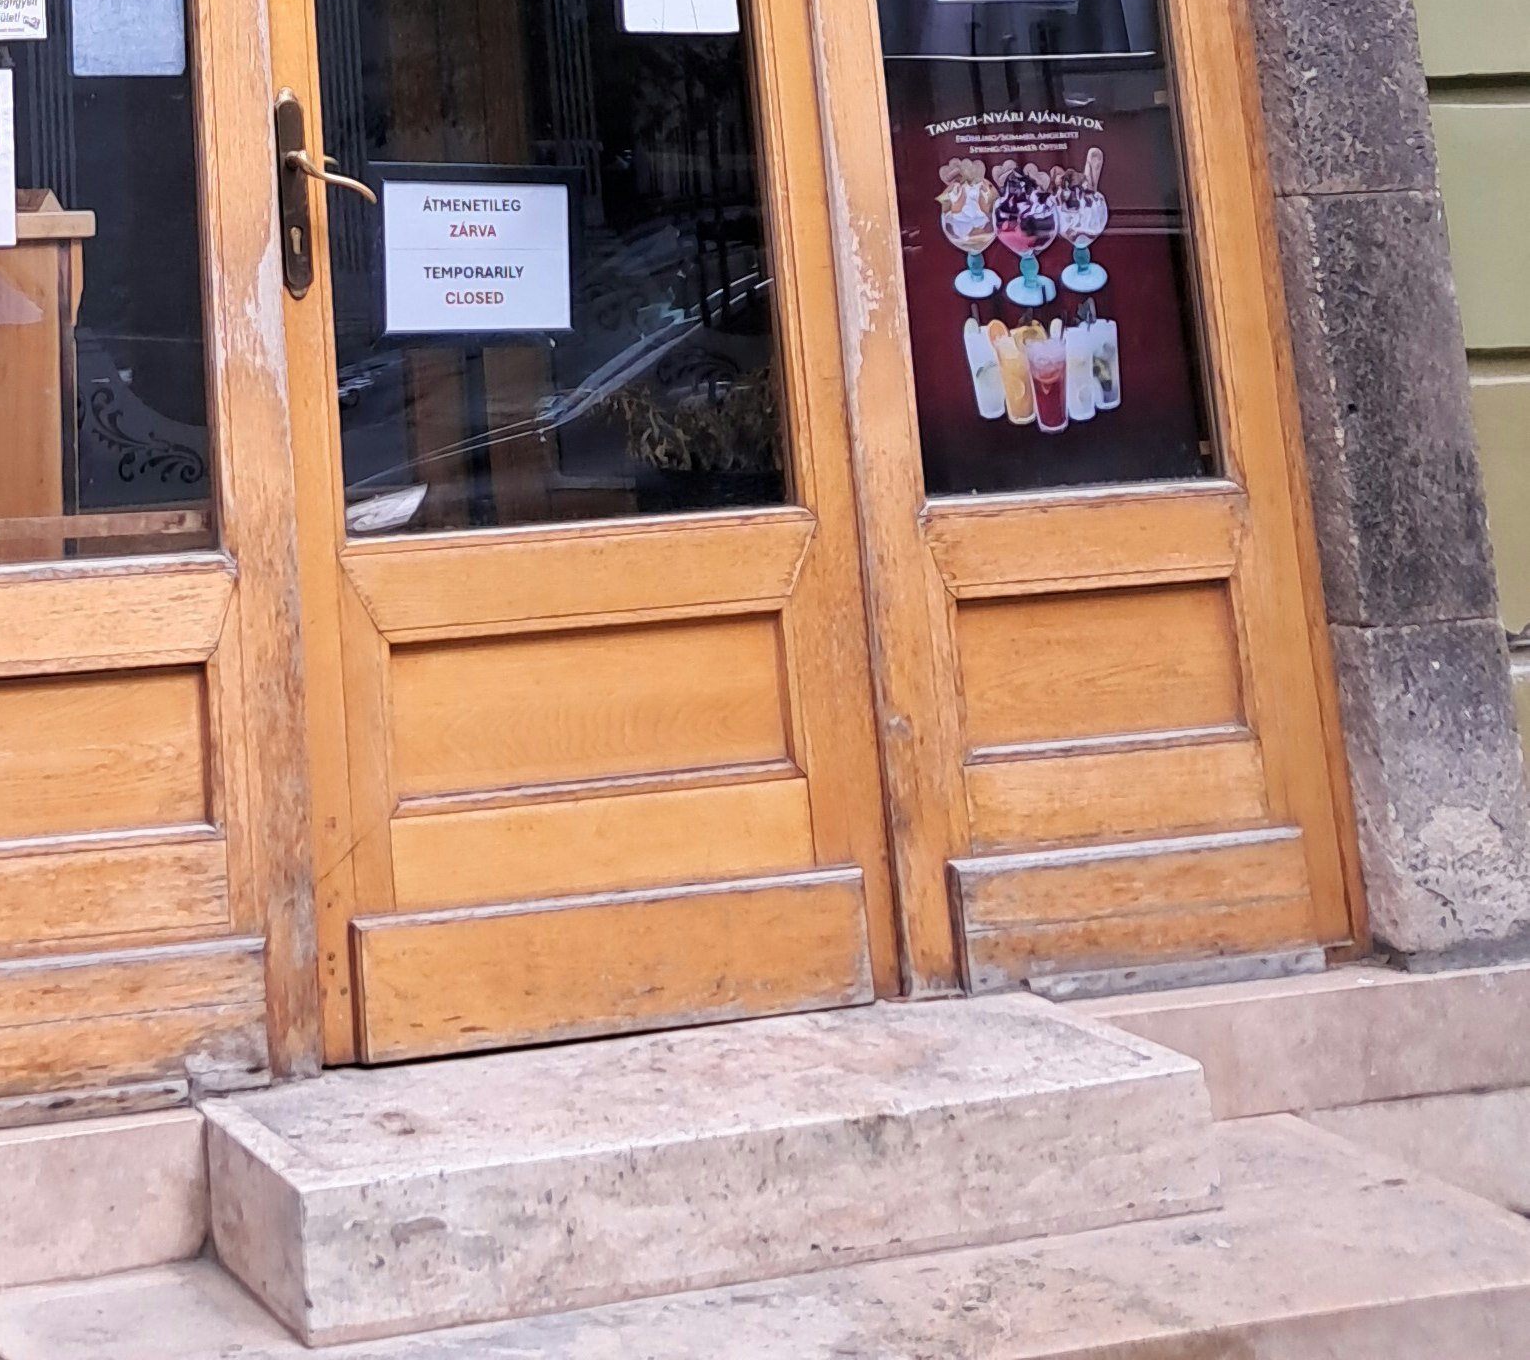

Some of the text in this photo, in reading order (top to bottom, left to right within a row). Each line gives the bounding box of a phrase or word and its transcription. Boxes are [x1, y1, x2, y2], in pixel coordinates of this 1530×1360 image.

[422, 196, 521, 212] ÁTMENETILEG
[450, 221, 496, 237] ZÁRVA
[423, 266, 524, 279] TEMPORARILY
[445, 291, 504, 304] CLOSED
